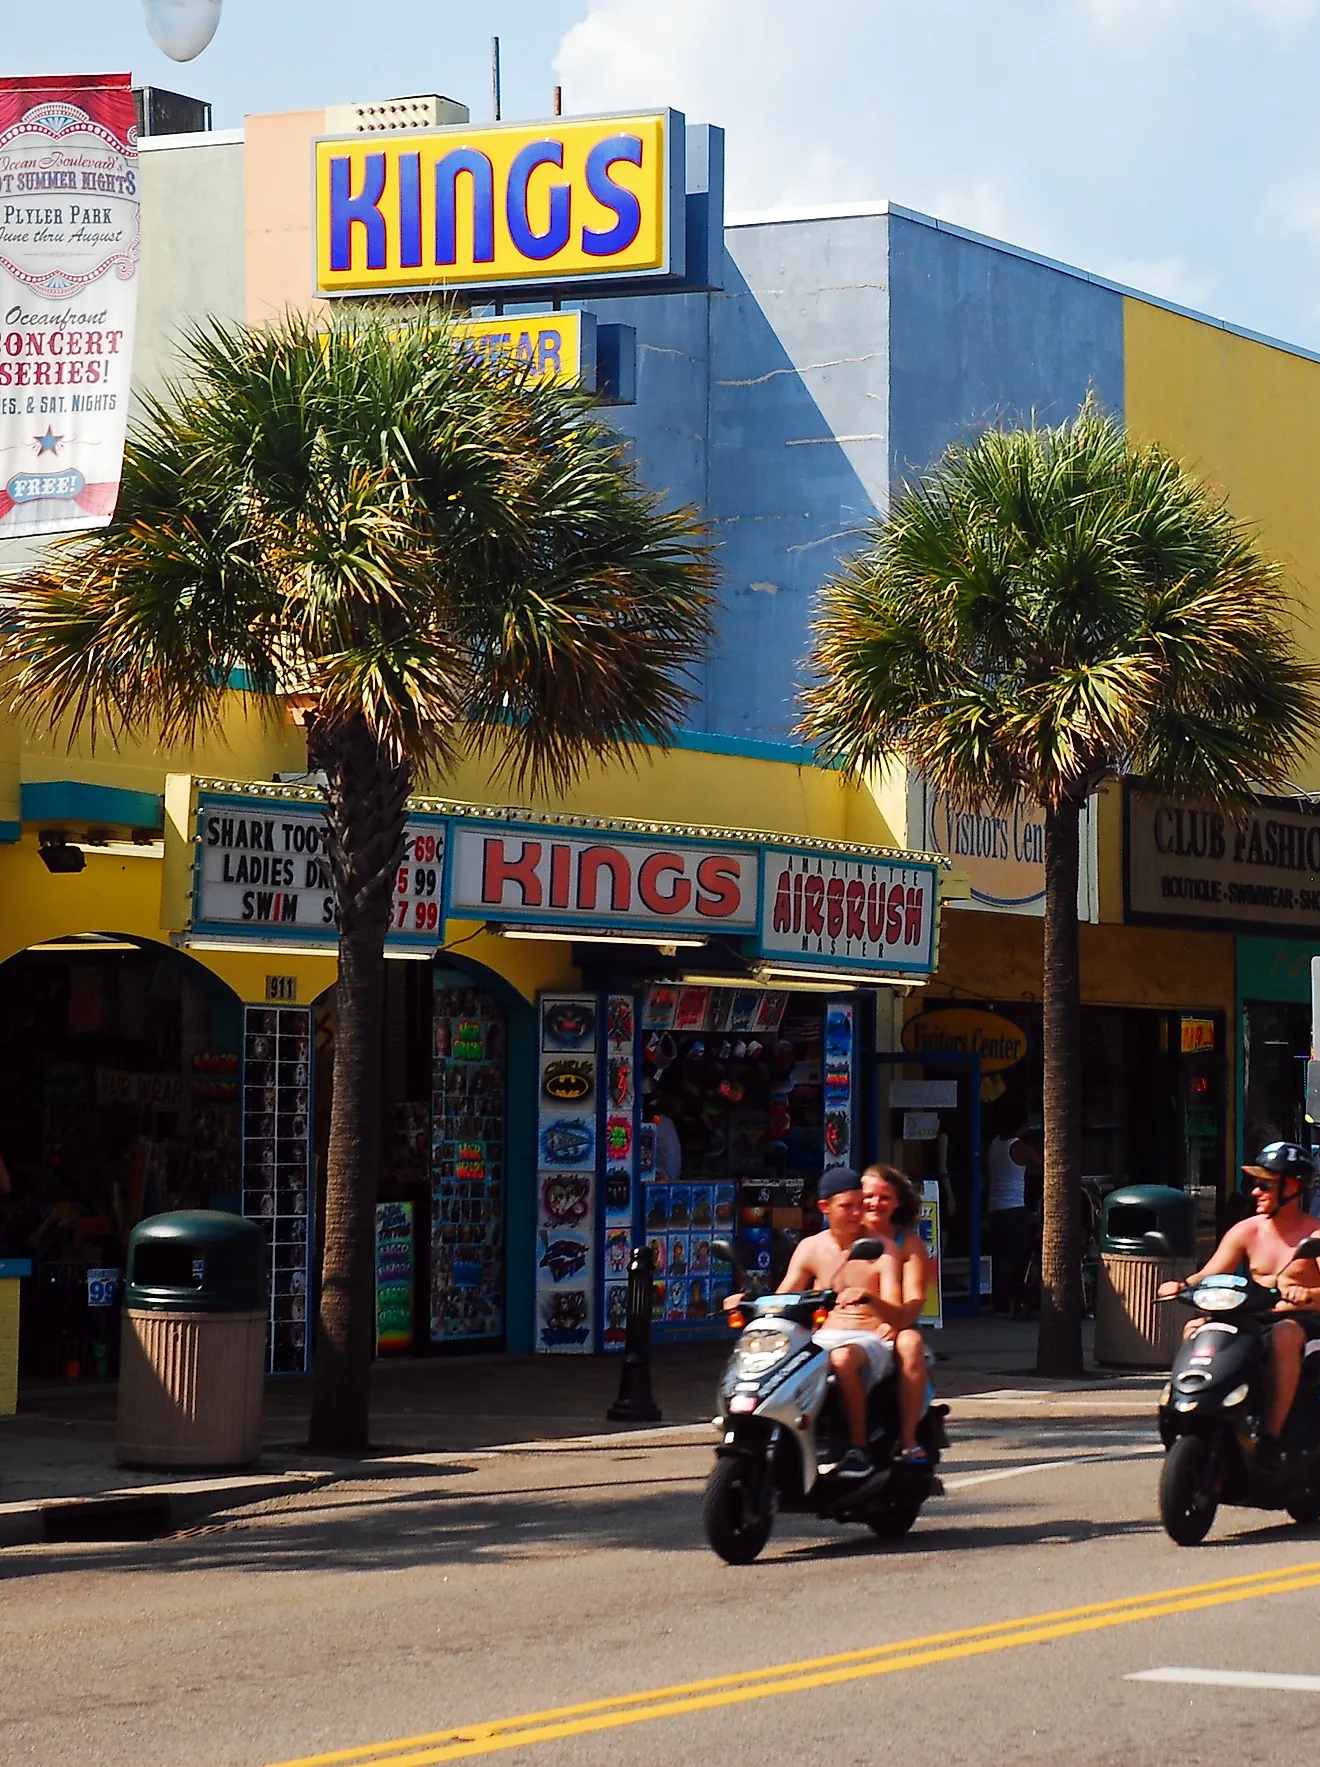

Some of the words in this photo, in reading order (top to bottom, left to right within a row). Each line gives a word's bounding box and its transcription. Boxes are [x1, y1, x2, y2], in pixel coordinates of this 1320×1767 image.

[17, 170, 77, 191] SUMMER
[81, 170, 136, 196] NIGHTS
[69, 205, 112, 225] PARK
[329, 133, 643, 272] KINGS
[33, 227, 64, 243] thru
[68, 226, 123, 247] August
[5, 305, 108, 331] Oceanfront
[0, 330, 123, 357] ONCERT
[26, 396, 35, 414] &
[40, 396, 67, 414] SAT.
[71, 393, 117, 412] NIGHTS
[14, 475, 77, 498] FREE!
[207, 817, 275, 853] SHARK
[1154, 807, 1226, 859] CLUB
[223, 853, 294, 886] LADIES
[482, 838, 742, 917] KINGS
[787, 856, 878, 882] AMAZING
[889, 867, 919, 887] TEE
[242, 891, 298, 922] SWIM
[773, 870, 924, 947] AIRBRUSH
[801, 935, 887, 959] MASTER
[270, 976, 293, 999] 911
